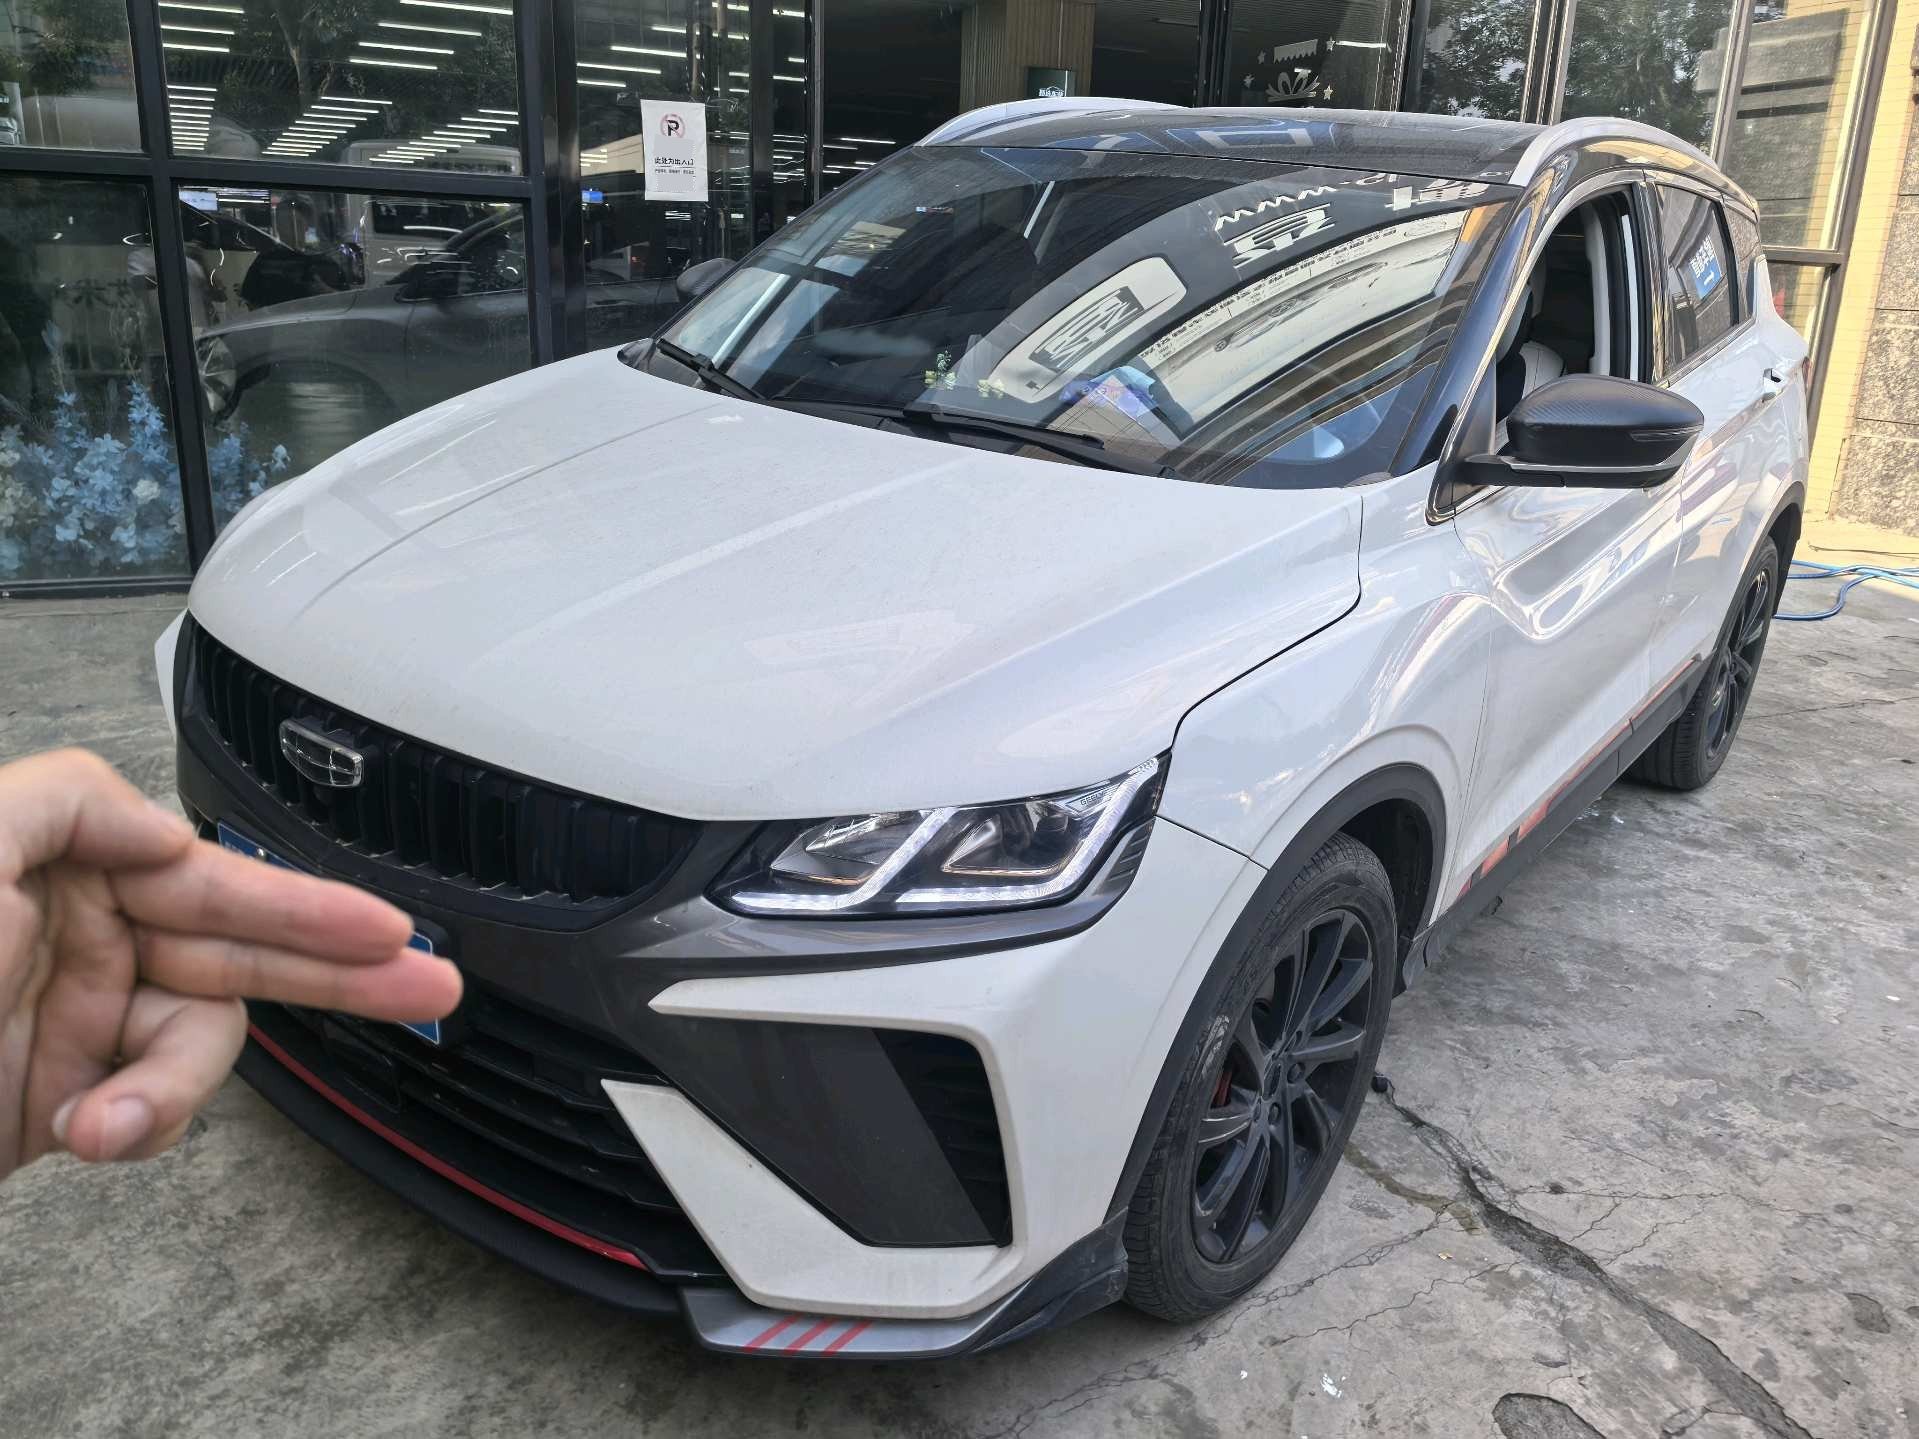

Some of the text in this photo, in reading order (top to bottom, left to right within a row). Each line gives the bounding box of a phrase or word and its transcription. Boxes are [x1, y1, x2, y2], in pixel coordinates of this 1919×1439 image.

[655, 157, 693, 165] 此处为出入口
[1081, 791, 1104, 805] GEELY
